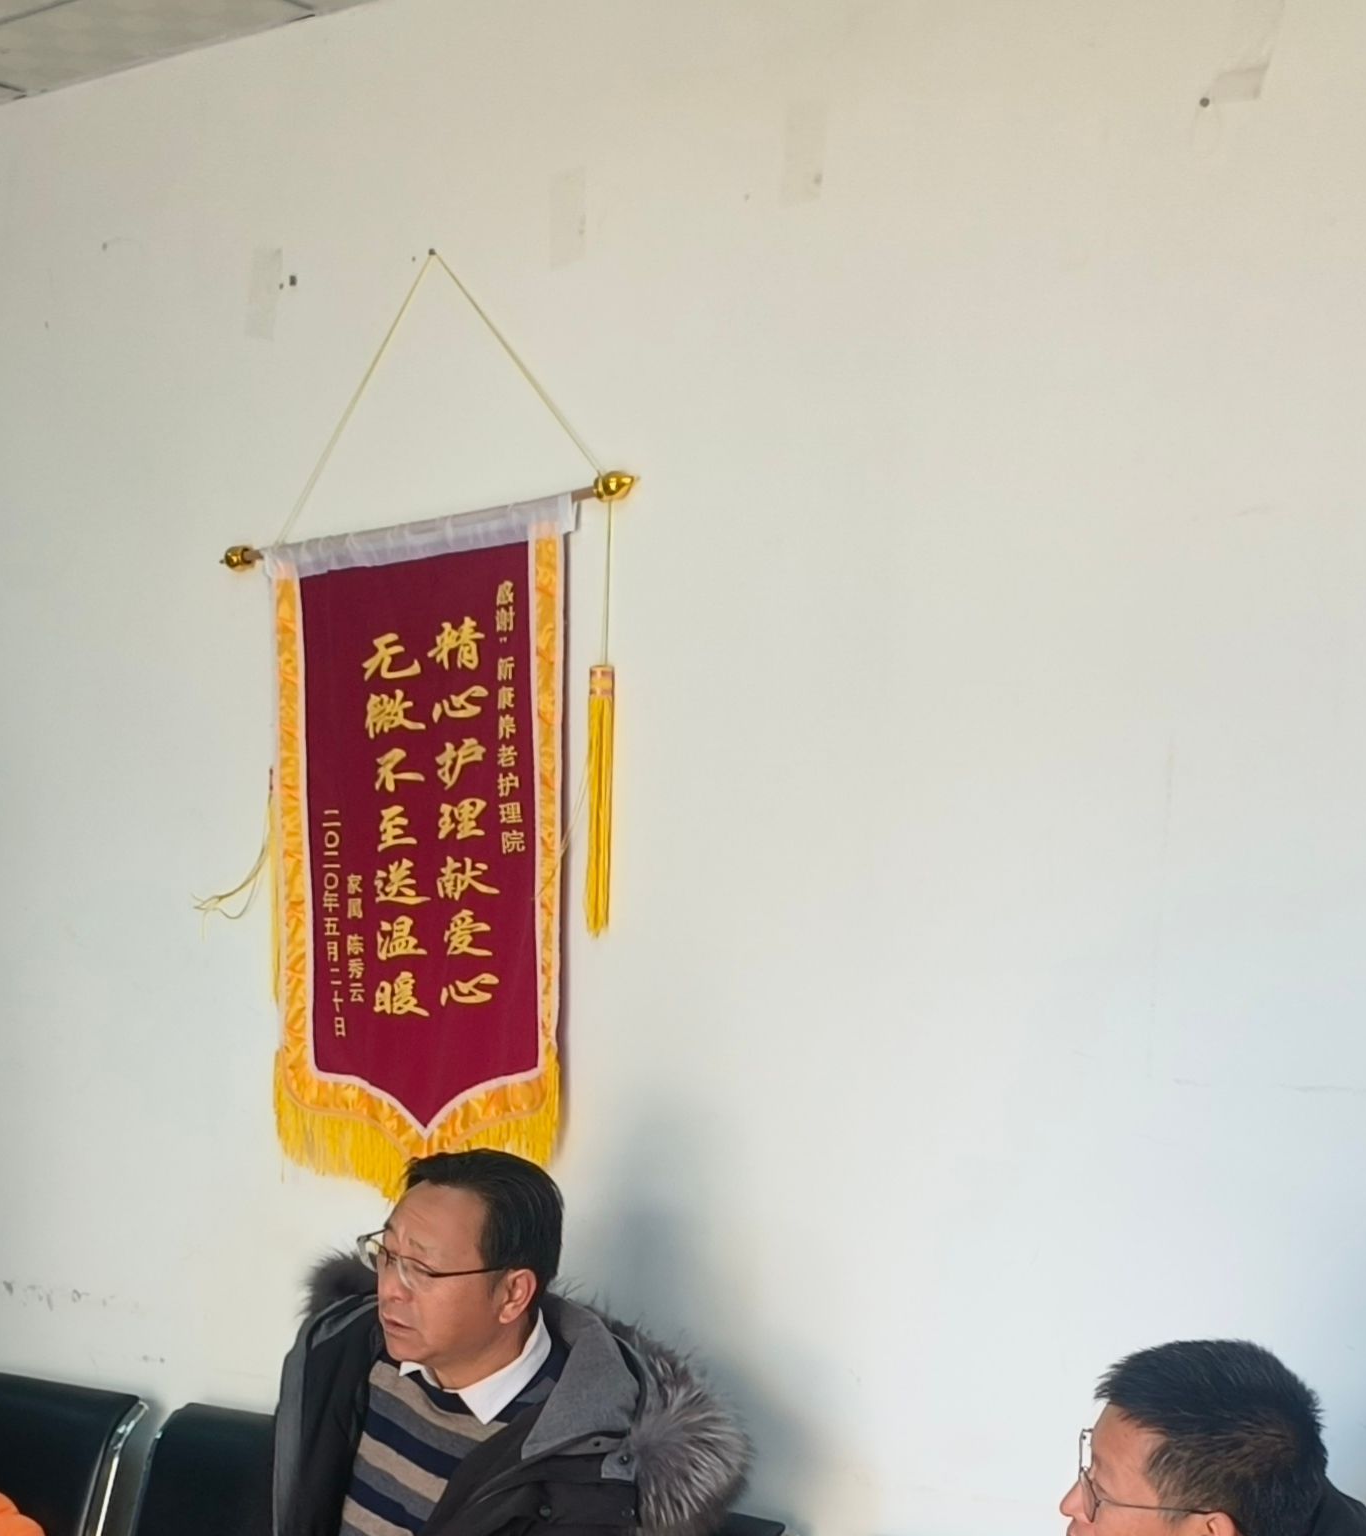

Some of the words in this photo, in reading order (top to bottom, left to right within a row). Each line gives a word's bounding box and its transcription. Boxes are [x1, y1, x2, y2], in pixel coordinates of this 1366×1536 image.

[362, 632, 432, 1017] 无微不至送温暖
[427, 615, 500, 1007] 精心护理献爱心
